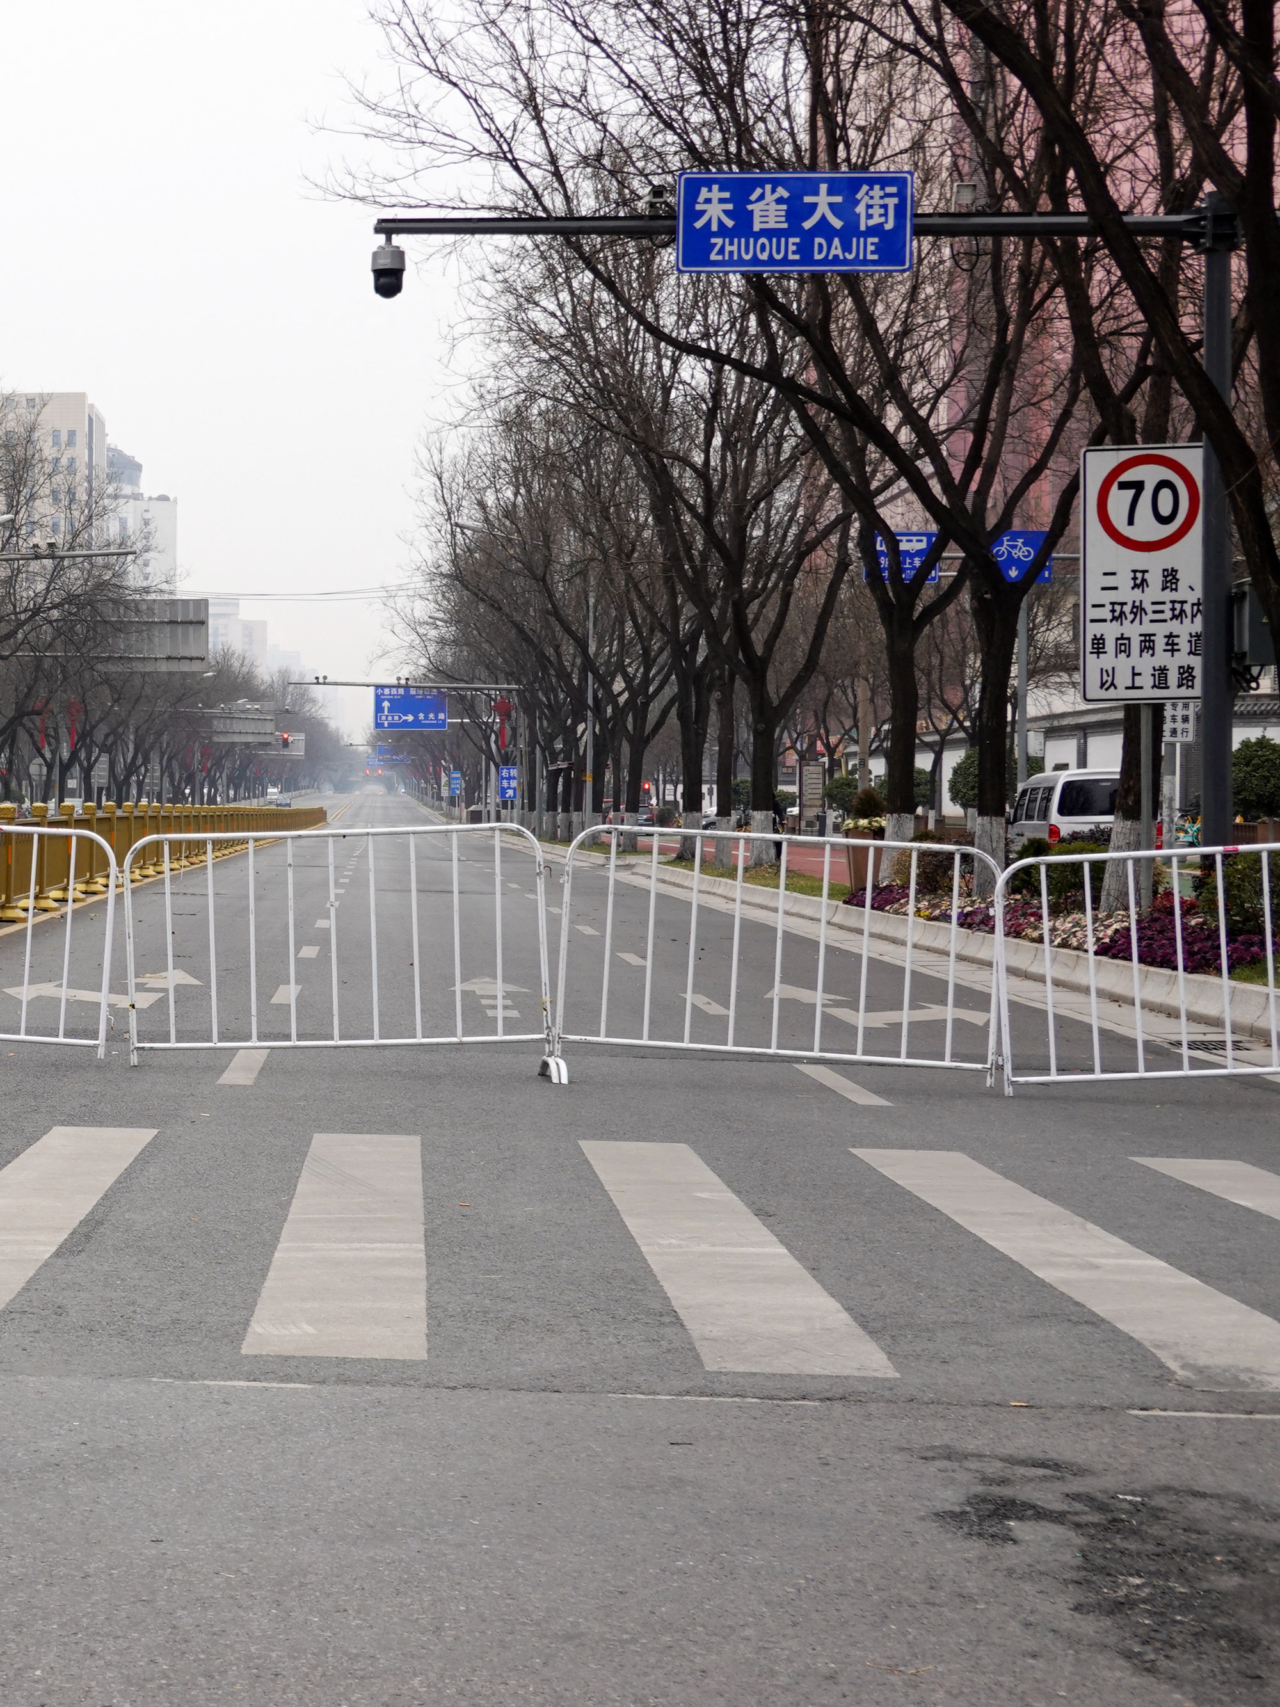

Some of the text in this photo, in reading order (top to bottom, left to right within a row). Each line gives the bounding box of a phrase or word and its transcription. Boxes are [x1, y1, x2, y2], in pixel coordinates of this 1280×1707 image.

[693, 184, 899, 232] 朱雀大街
[710, 237, 879, 261] ZHUQUE DAJIE
[1117, 479, 1180, 527] 70
[1089, 598, 1202, 626] 二环外三环内
[1089, 631, 1202, 659] 单向两车道
[1099, 664, 1196, 691] 以上道路
[1163, 702, 1190, 711] 专用
[501, 768, 517, 777] 右转
[501, 779, 517, 788] 车辆
